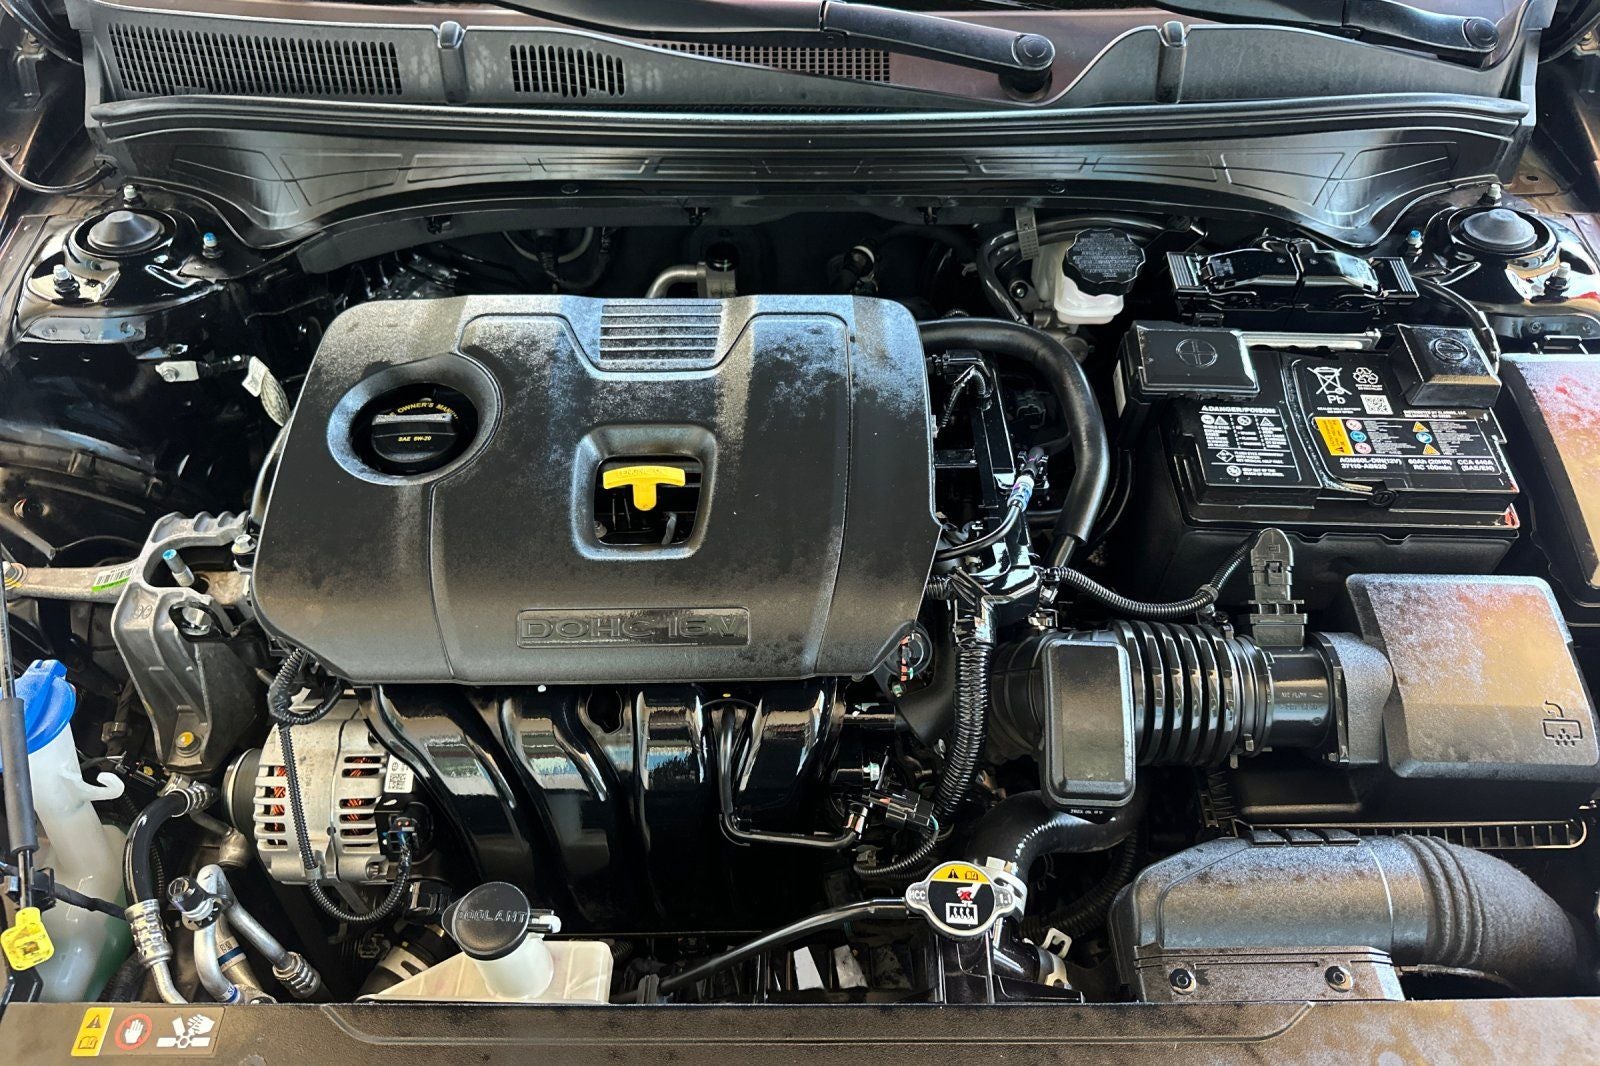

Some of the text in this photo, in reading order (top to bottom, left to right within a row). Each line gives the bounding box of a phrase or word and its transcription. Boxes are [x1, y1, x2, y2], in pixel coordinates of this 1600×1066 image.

[1327, 395, 1346, 405] Pb
[397, 402, 434, 414] OWNER'S
[521, 617, 656, 640] DOHC
[908, 891, 926, 900] HCC
[1000, 893, 1012, 904] 1.1
